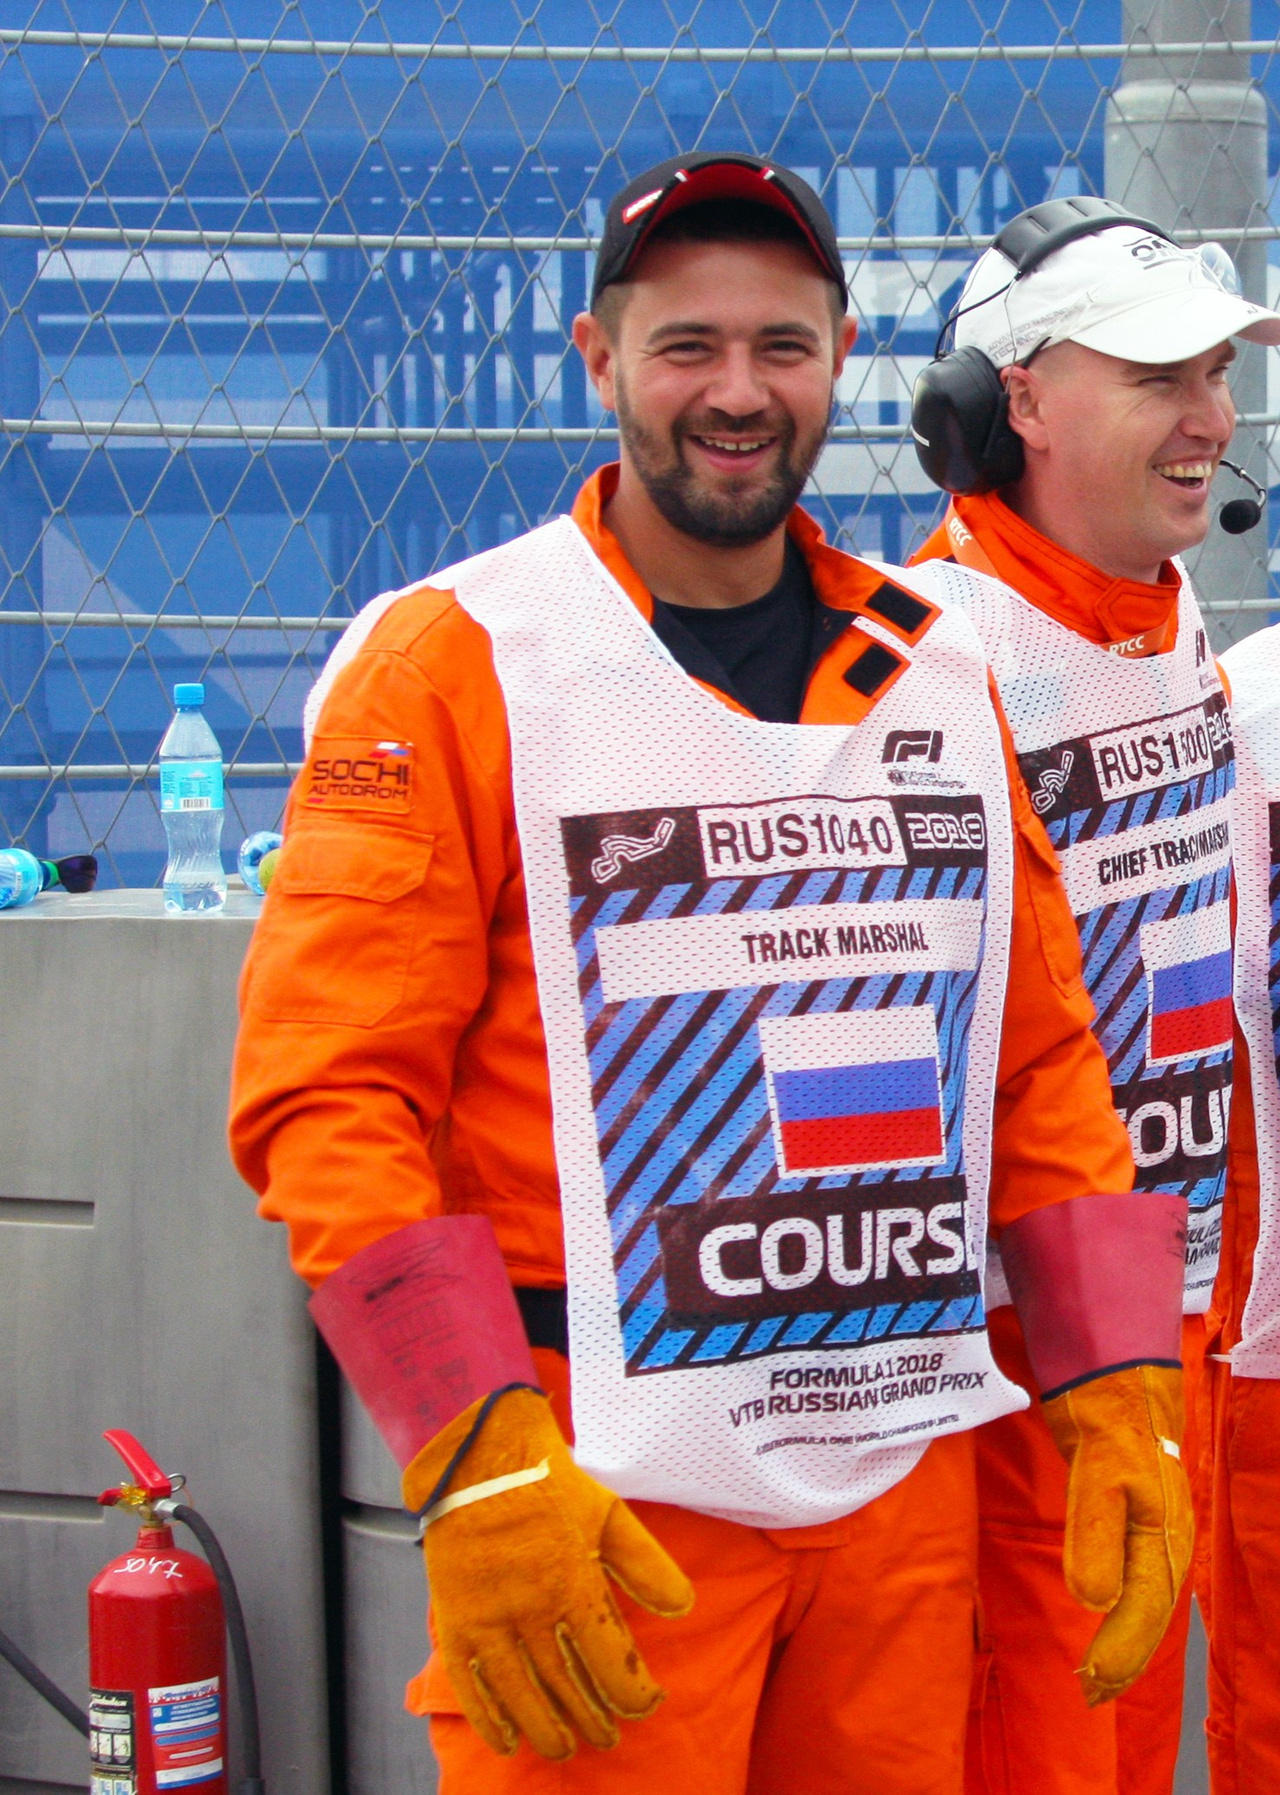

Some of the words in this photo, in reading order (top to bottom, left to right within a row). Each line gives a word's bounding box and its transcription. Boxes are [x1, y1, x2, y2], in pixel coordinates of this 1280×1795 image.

[949, 517, 972, 547] RTCC
[309, 784, 406, 799] AUTODROM
[311, 759, 408, 786] SOCHI
[707, 813, 893, 864] RUS1040
[1100, 847, 1148, 885] CHIEF
[741, 929, 831, 963] TRACK
[837, 922, 929, 955] MARSHAL
[769, 1359, 884, 1391] FORMULA
[896, 1353, 943, 1376] 2018
[728, 1399, 765, 1428] VTB
[767, 1386, 880, 1416] RUSSIAN
[881, 1376, 936, 1405] GRAND
[938, 1371, 989, 1394] PRIX
